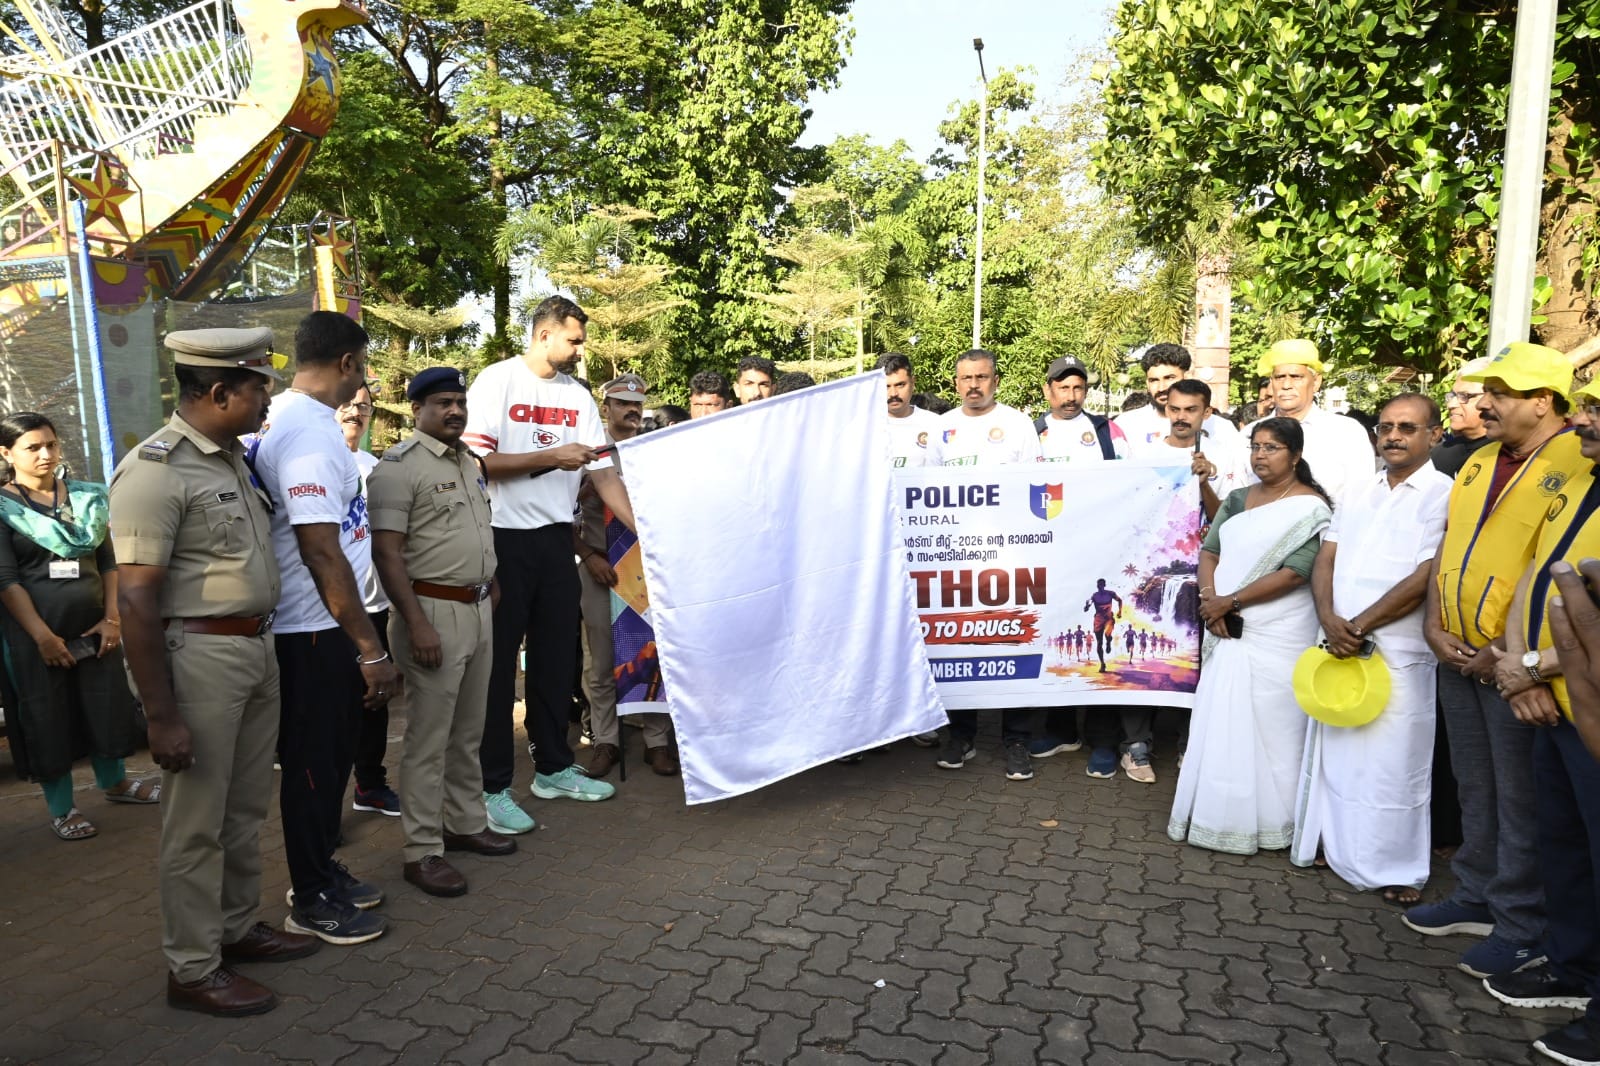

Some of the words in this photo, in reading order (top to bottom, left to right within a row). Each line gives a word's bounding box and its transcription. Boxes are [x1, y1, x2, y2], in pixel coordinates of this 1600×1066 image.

[905, 484, 1000, 510] POLICE
[908, 514, 960, 526] RURAL
[1008, 530, 1053, 545] ഭാഗമായി
[934, 620, 958, 638] TO
[960, 619, 1026, 637] DRUGS.
[929, 662, 973, 679] MBER
[978, 660, 1016, 677] 2026
